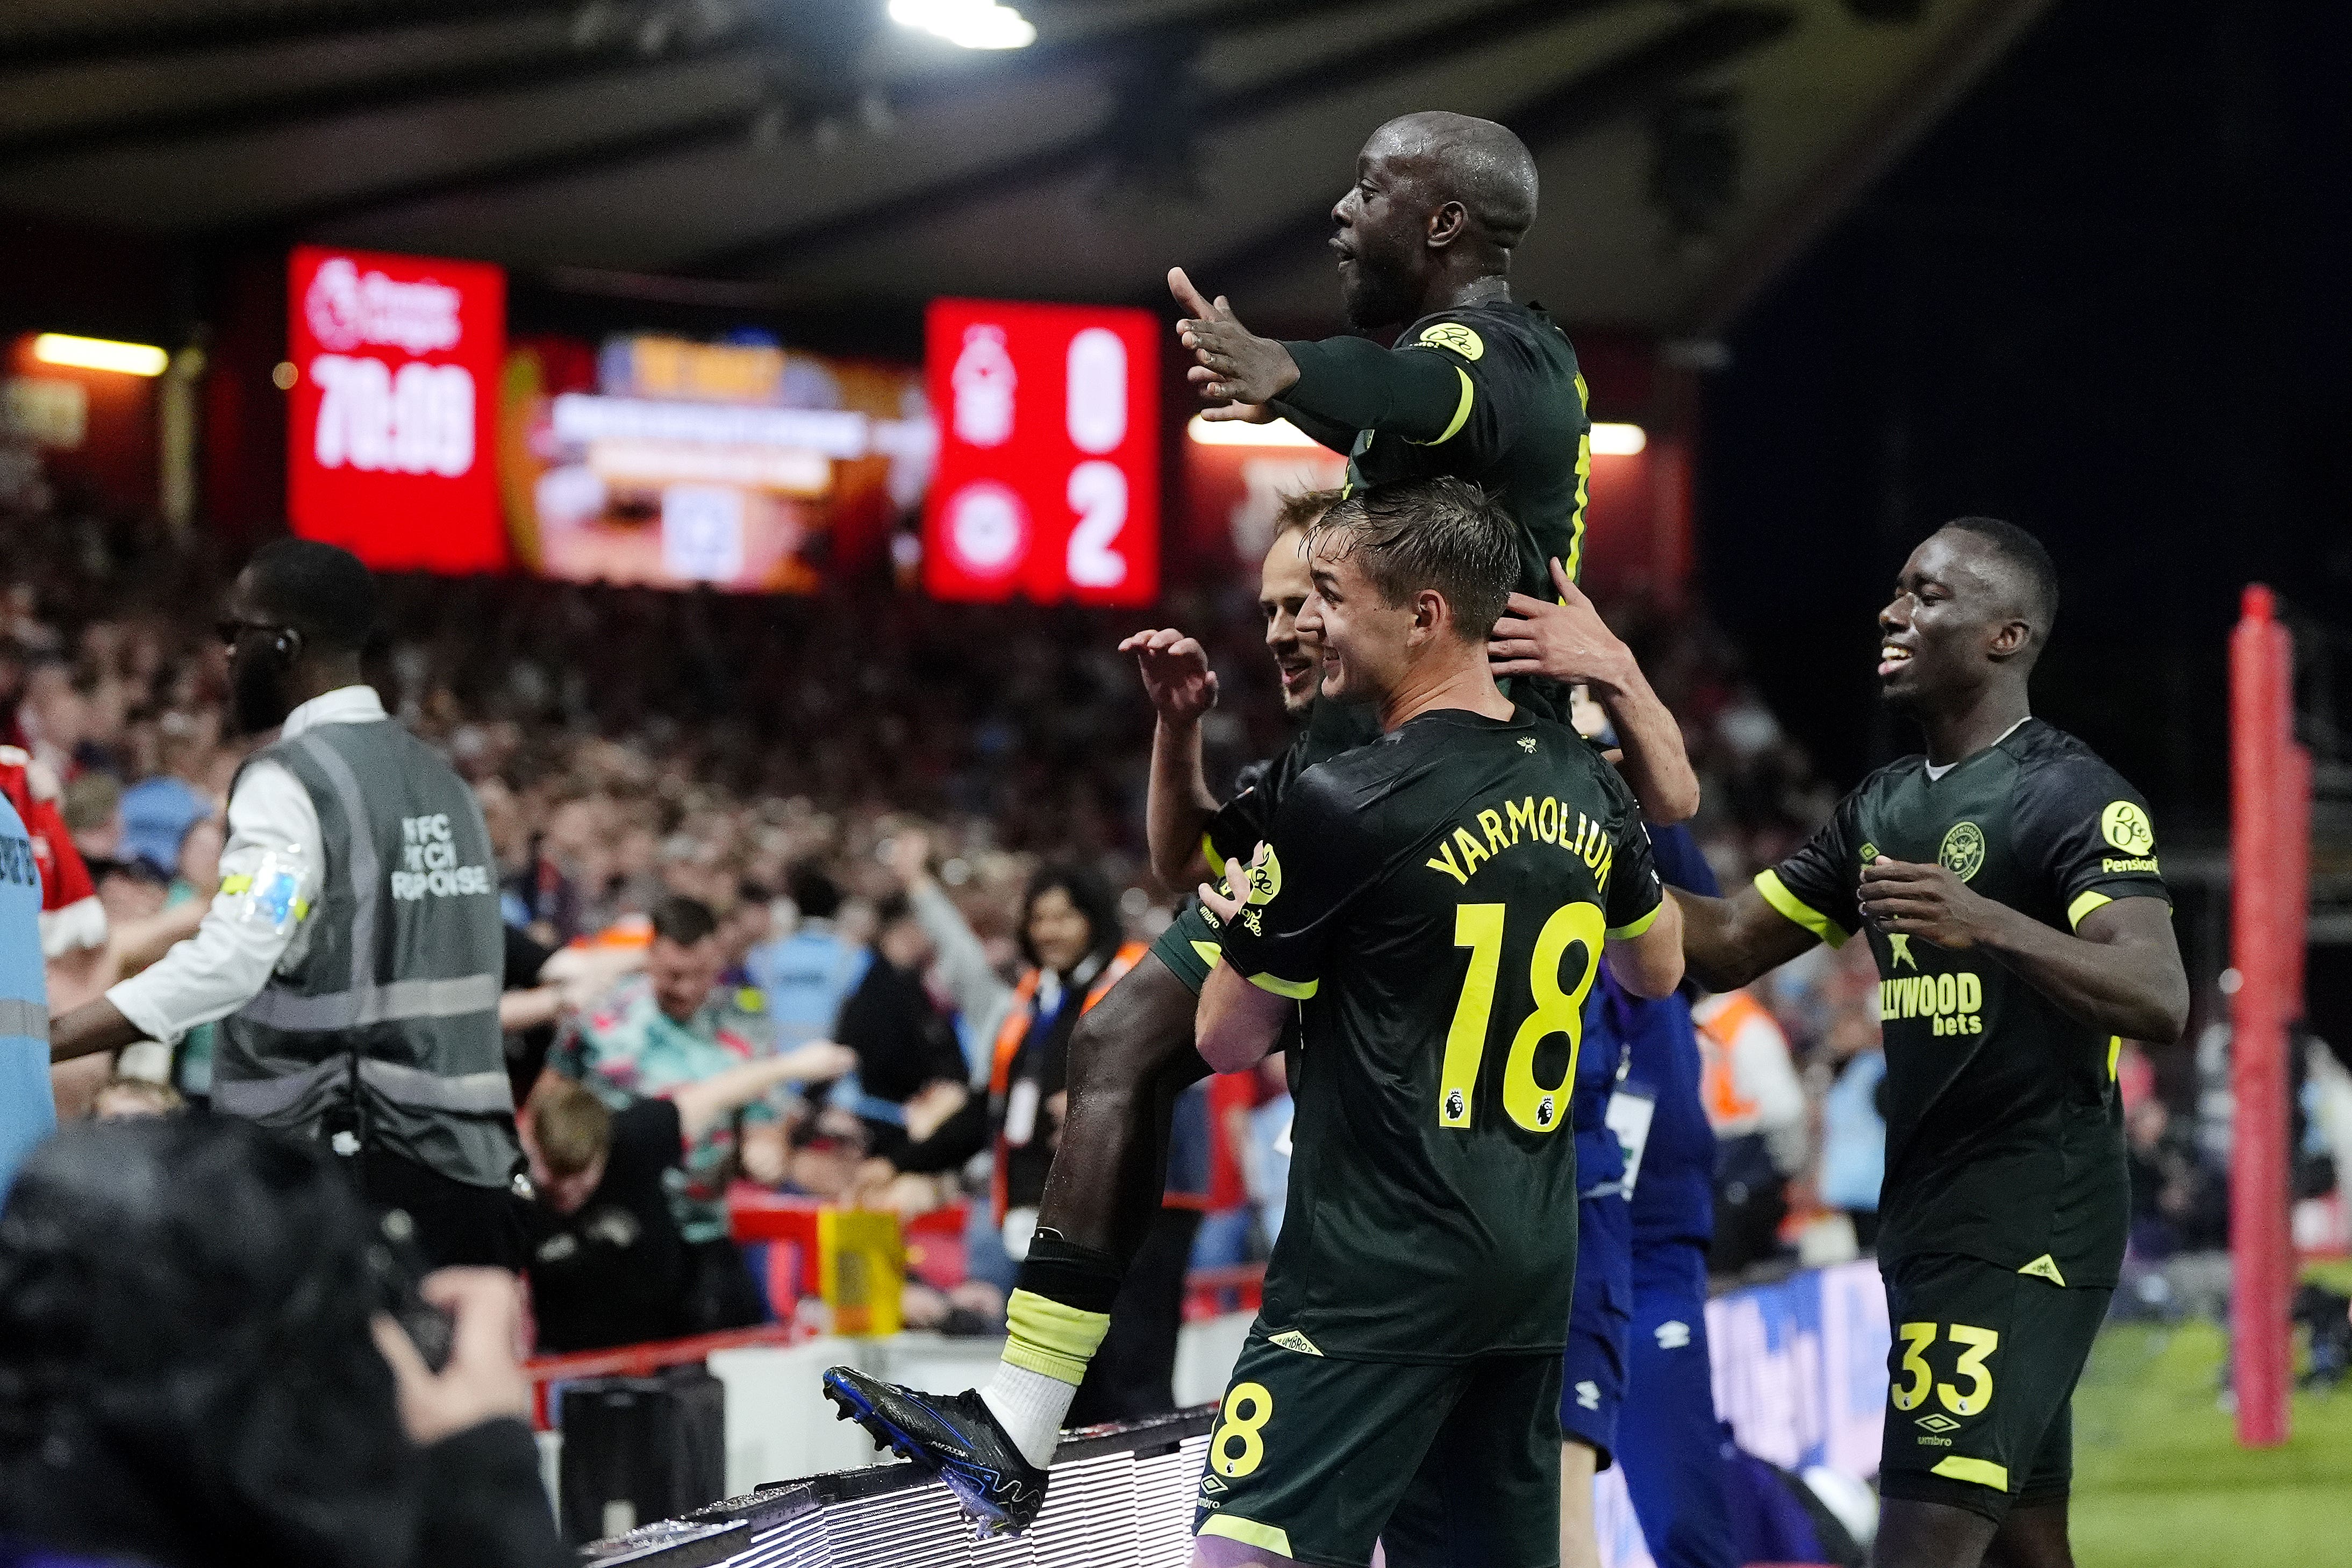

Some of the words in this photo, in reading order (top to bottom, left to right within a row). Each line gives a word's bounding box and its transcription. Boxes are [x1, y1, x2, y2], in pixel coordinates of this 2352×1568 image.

[1067, 329, 1127, 453] 0
[1067, 461, 1127, 586] 2
[1426, 796, 1612, 893] YARMOLIUK
[2103, 856, 2161, 875] Pension
[1199, 905, 1220, 929] umbro
[1439, 901, 1606, 1133] 18
[1879, 972, 1982, 1020] LLYWOOD
[1933, 1012, 1983, 1036] bets
[1282, 1335, 1307, 1351] UMBRO
[1891, 1322, 1998, 1416] 33
[1917, 1436, 1952, 1447] umbro
